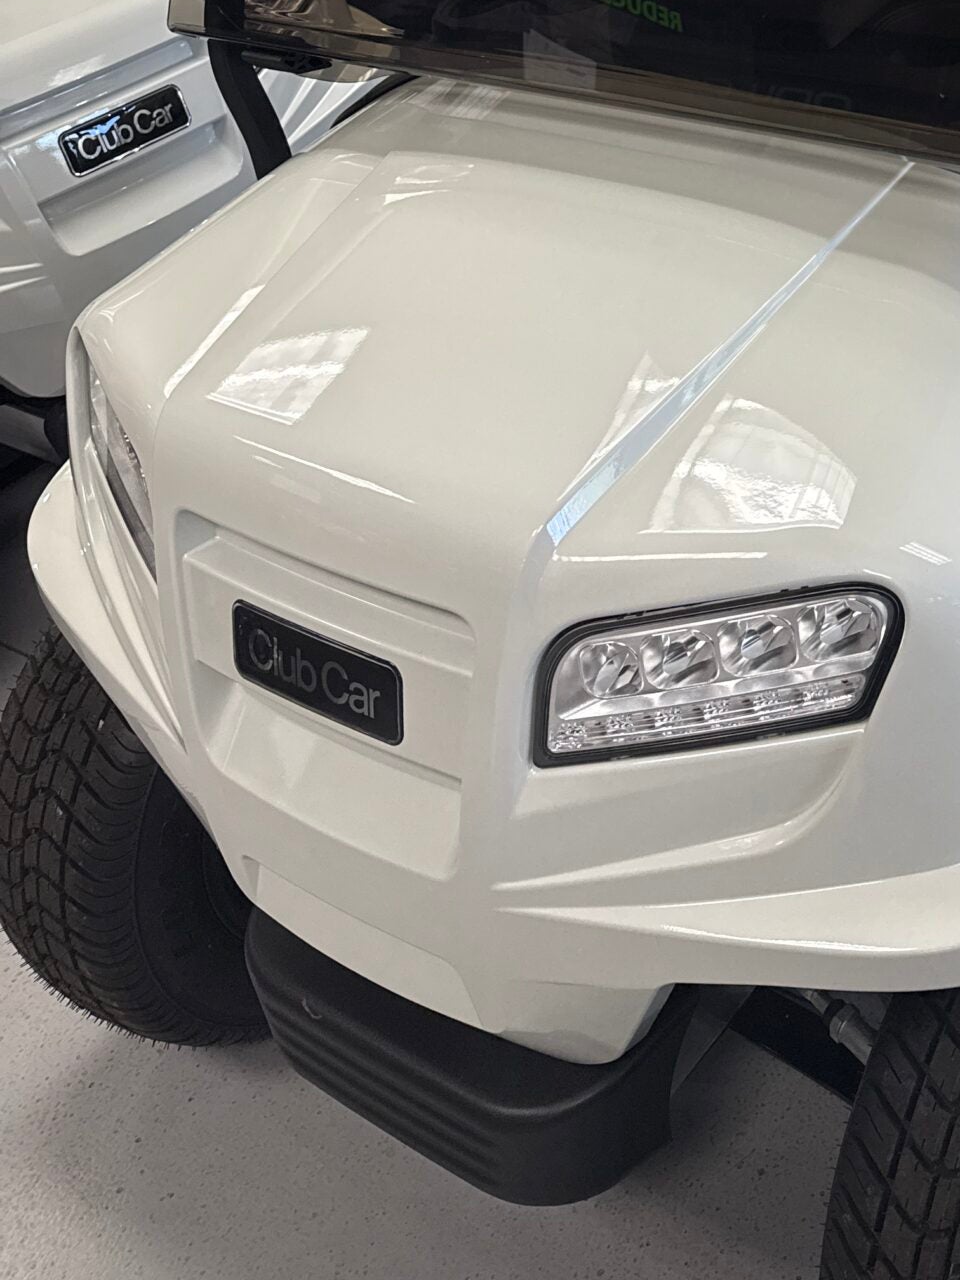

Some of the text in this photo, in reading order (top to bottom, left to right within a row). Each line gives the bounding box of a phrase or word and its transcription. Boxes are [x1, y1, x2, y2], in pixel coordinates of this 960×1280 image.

[77, 102, 174, 160] Club Car
[248, 628, 381, 719] Club Car
